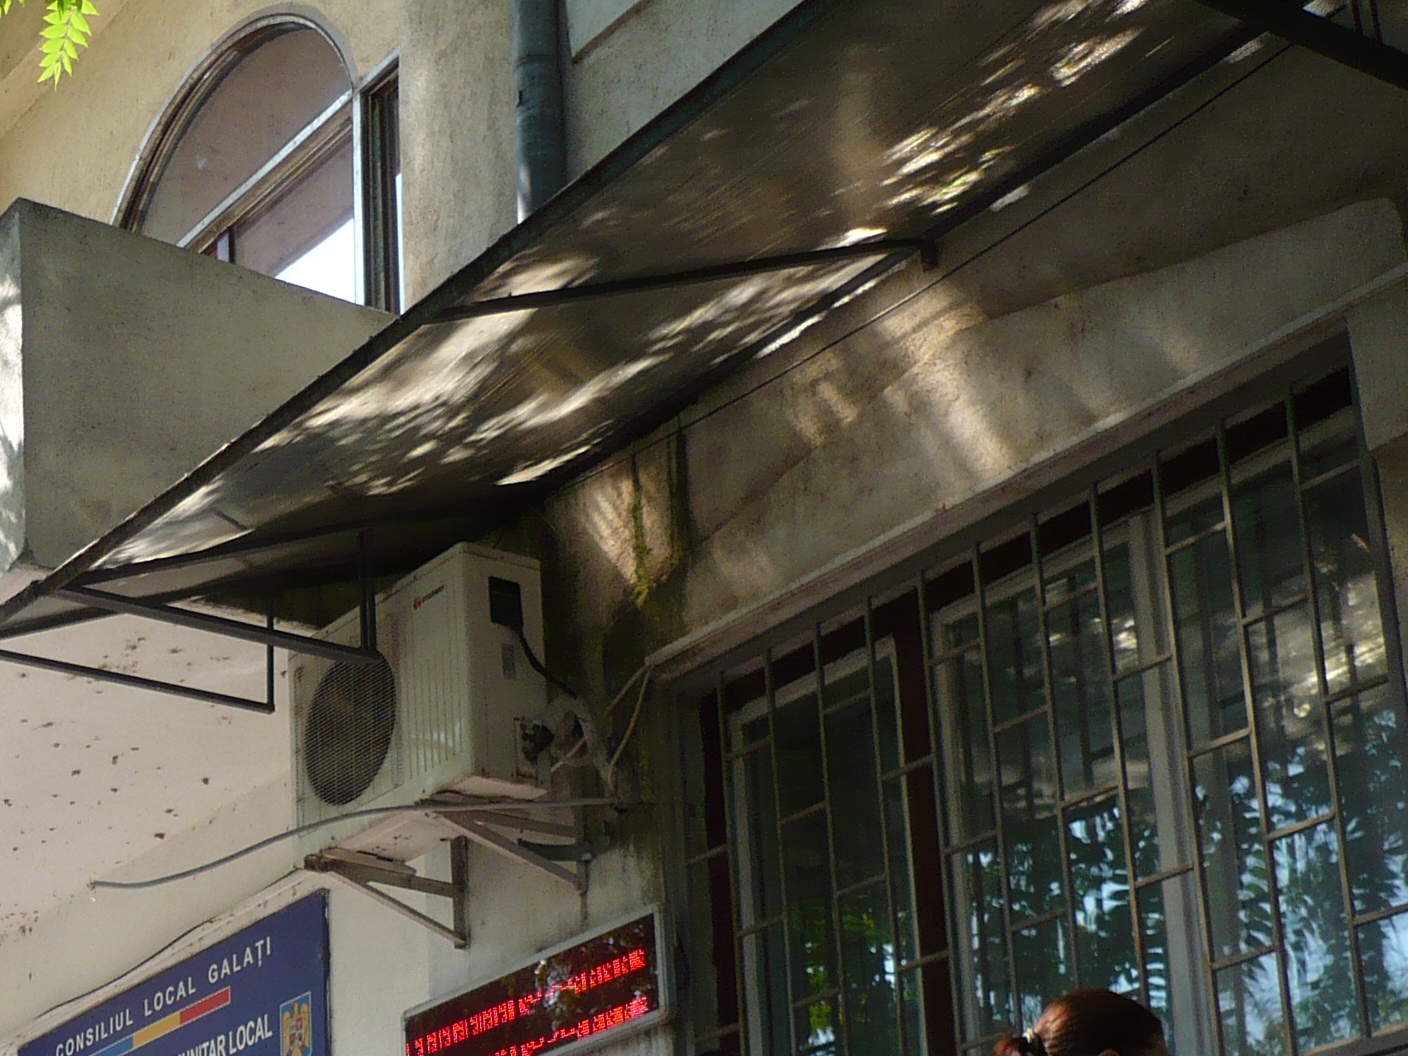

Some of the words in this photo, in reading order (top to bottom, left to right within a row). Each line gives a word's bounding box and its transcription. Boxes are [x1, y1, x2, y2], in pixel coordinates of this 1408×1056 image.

[144, 976, 196, 1017] LOCAL
[207, 936, 271, 984] GALAȚI
[228, 1013, 273, 1056] LOCAL
